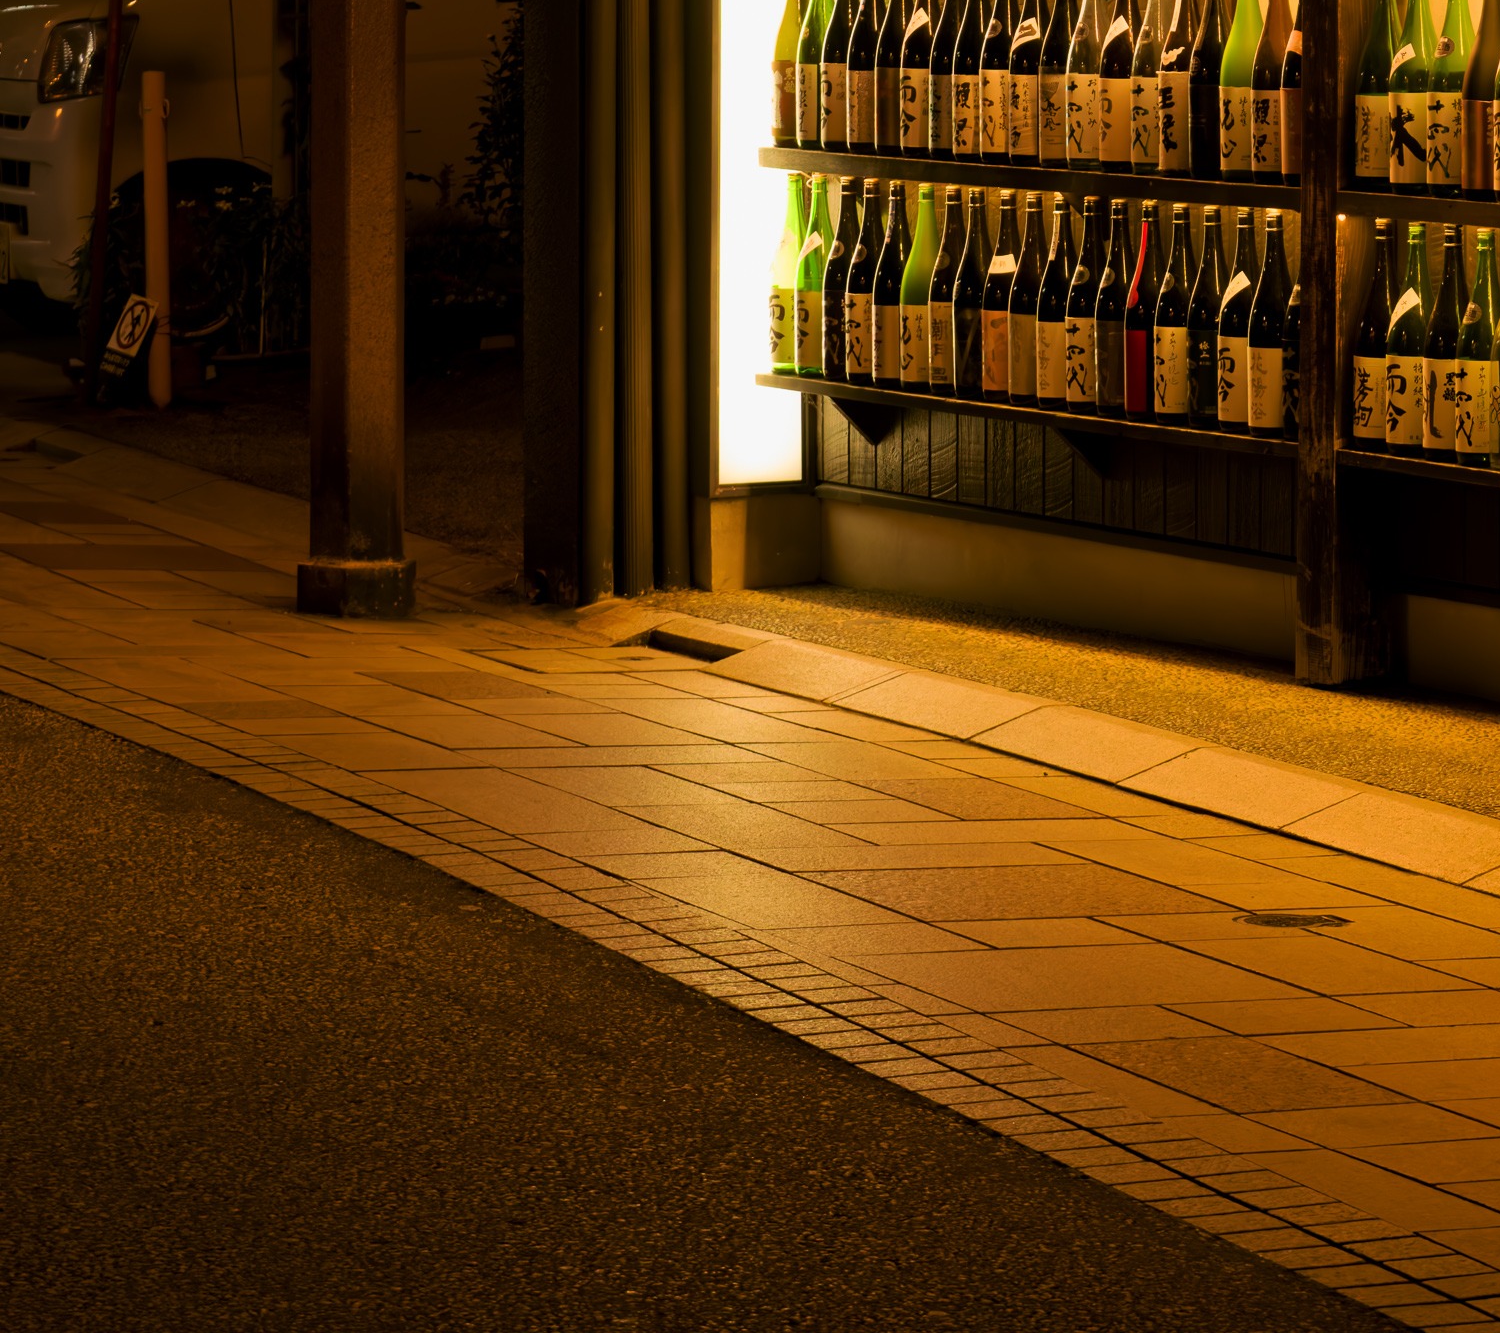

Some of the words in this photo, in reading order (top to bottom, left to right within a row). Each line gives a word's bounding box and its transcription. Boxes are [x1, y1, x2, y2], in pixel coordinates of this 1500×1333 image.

[900, 75, 917, 138] 而今
[1427, 99, 1450, 178] 十四代
[1066, 323, 1086, 396] 十四代
[1218, 347, 1236, 403] 而今
[1386, 364, 1406, 433] 而今
[1455, 368, 1475, 447] 十四代
